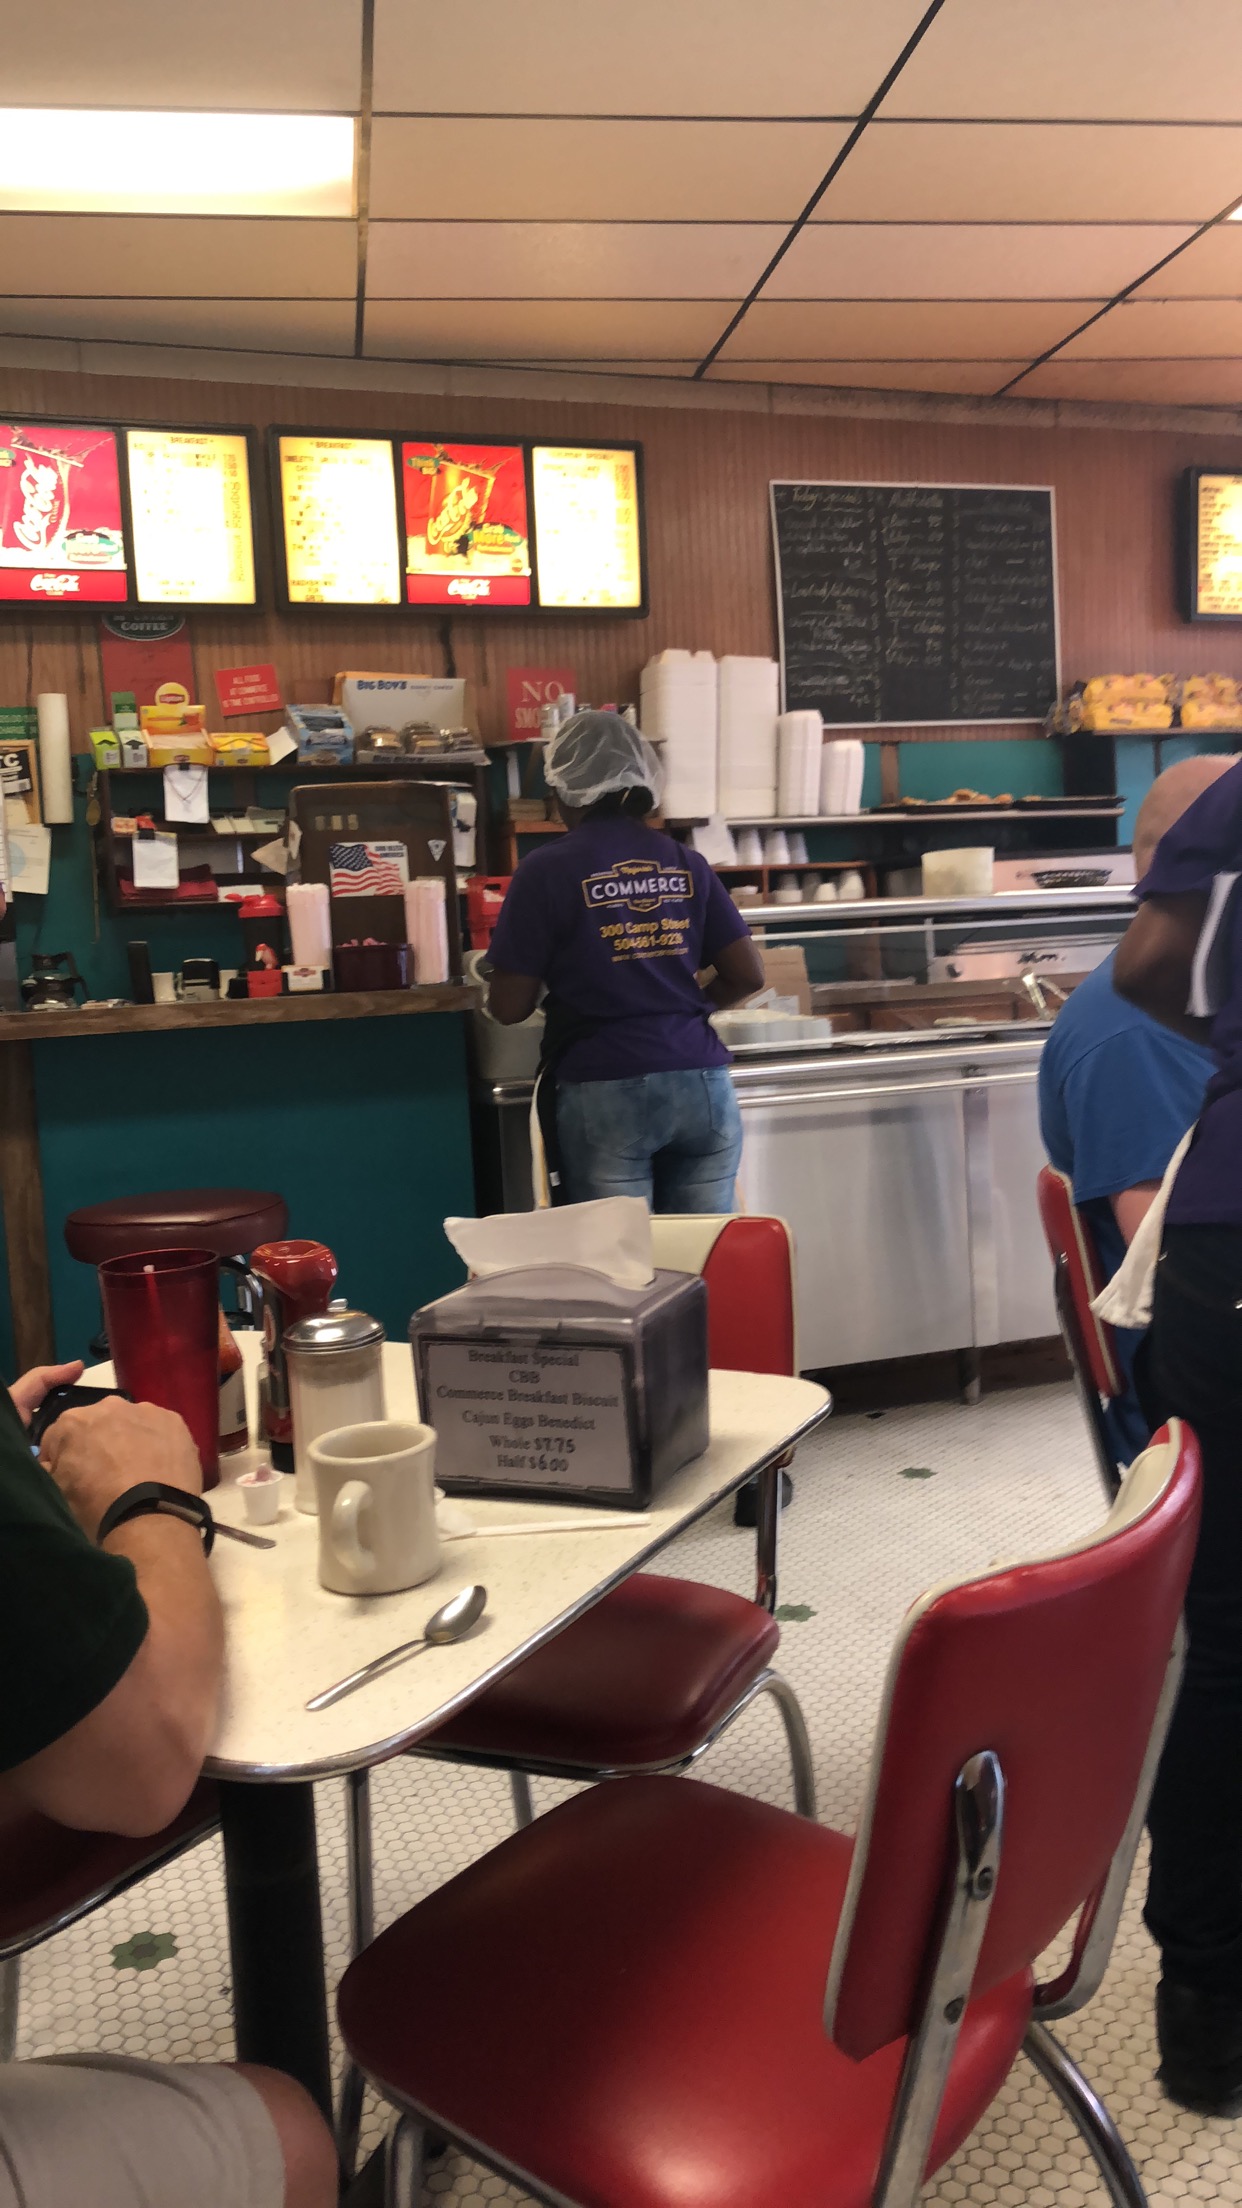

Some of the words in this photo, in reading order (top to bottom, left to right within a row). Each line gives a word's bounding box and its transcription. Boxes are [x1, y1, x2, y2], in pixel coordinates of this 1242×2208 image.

[120, 622, 168, 631] COFFEE
[520, 680, 565, 703] NO
[591, 877, 687, 899] COMMERCE
[599, 922, 625, 939] 300
[625, 921, 660, 935] Camp
[660, 917, 691, 931] Street
[468, 1349, 529, 1364] Breakfast
[531, 1351, 579, 1369] Special
[508, 1369, 541, 1384] CBB
[436, 1384, 505, 1401] Commerce
[507, 1388, 569, 1405] Breakfast
[572, 1392, 619, 1408] Biscuit
[462, 1409, 500, 1426] Cajun
[503, 1411, 535, 1429] Eggs
[537, 1413, 596, 1430] Benedict
[488, 1434, 531, 1450] Whole
[496, 1453, 527, 1468] Half
